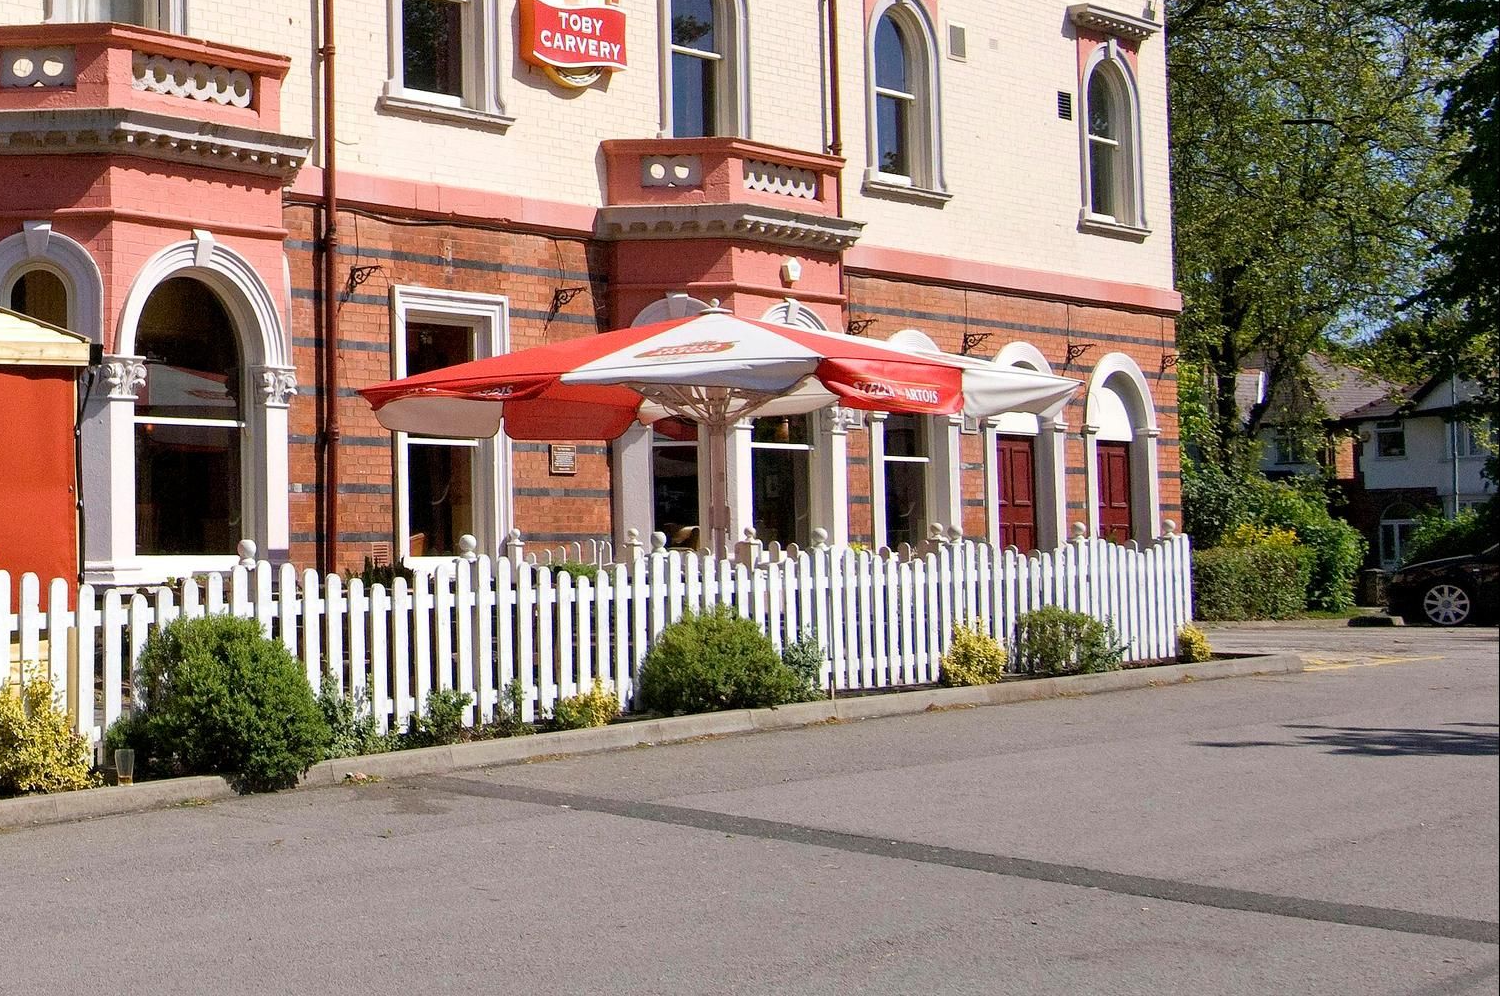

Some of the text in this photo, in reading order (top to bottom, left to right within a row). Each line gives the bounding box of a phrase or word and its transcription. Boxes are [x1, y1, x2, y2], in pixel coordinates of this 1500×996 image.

[558, 11, 603, 36] TOBY
[540, 30, 621, 60] CARVERY
[905, 388, 939, 404] ARTOIS
